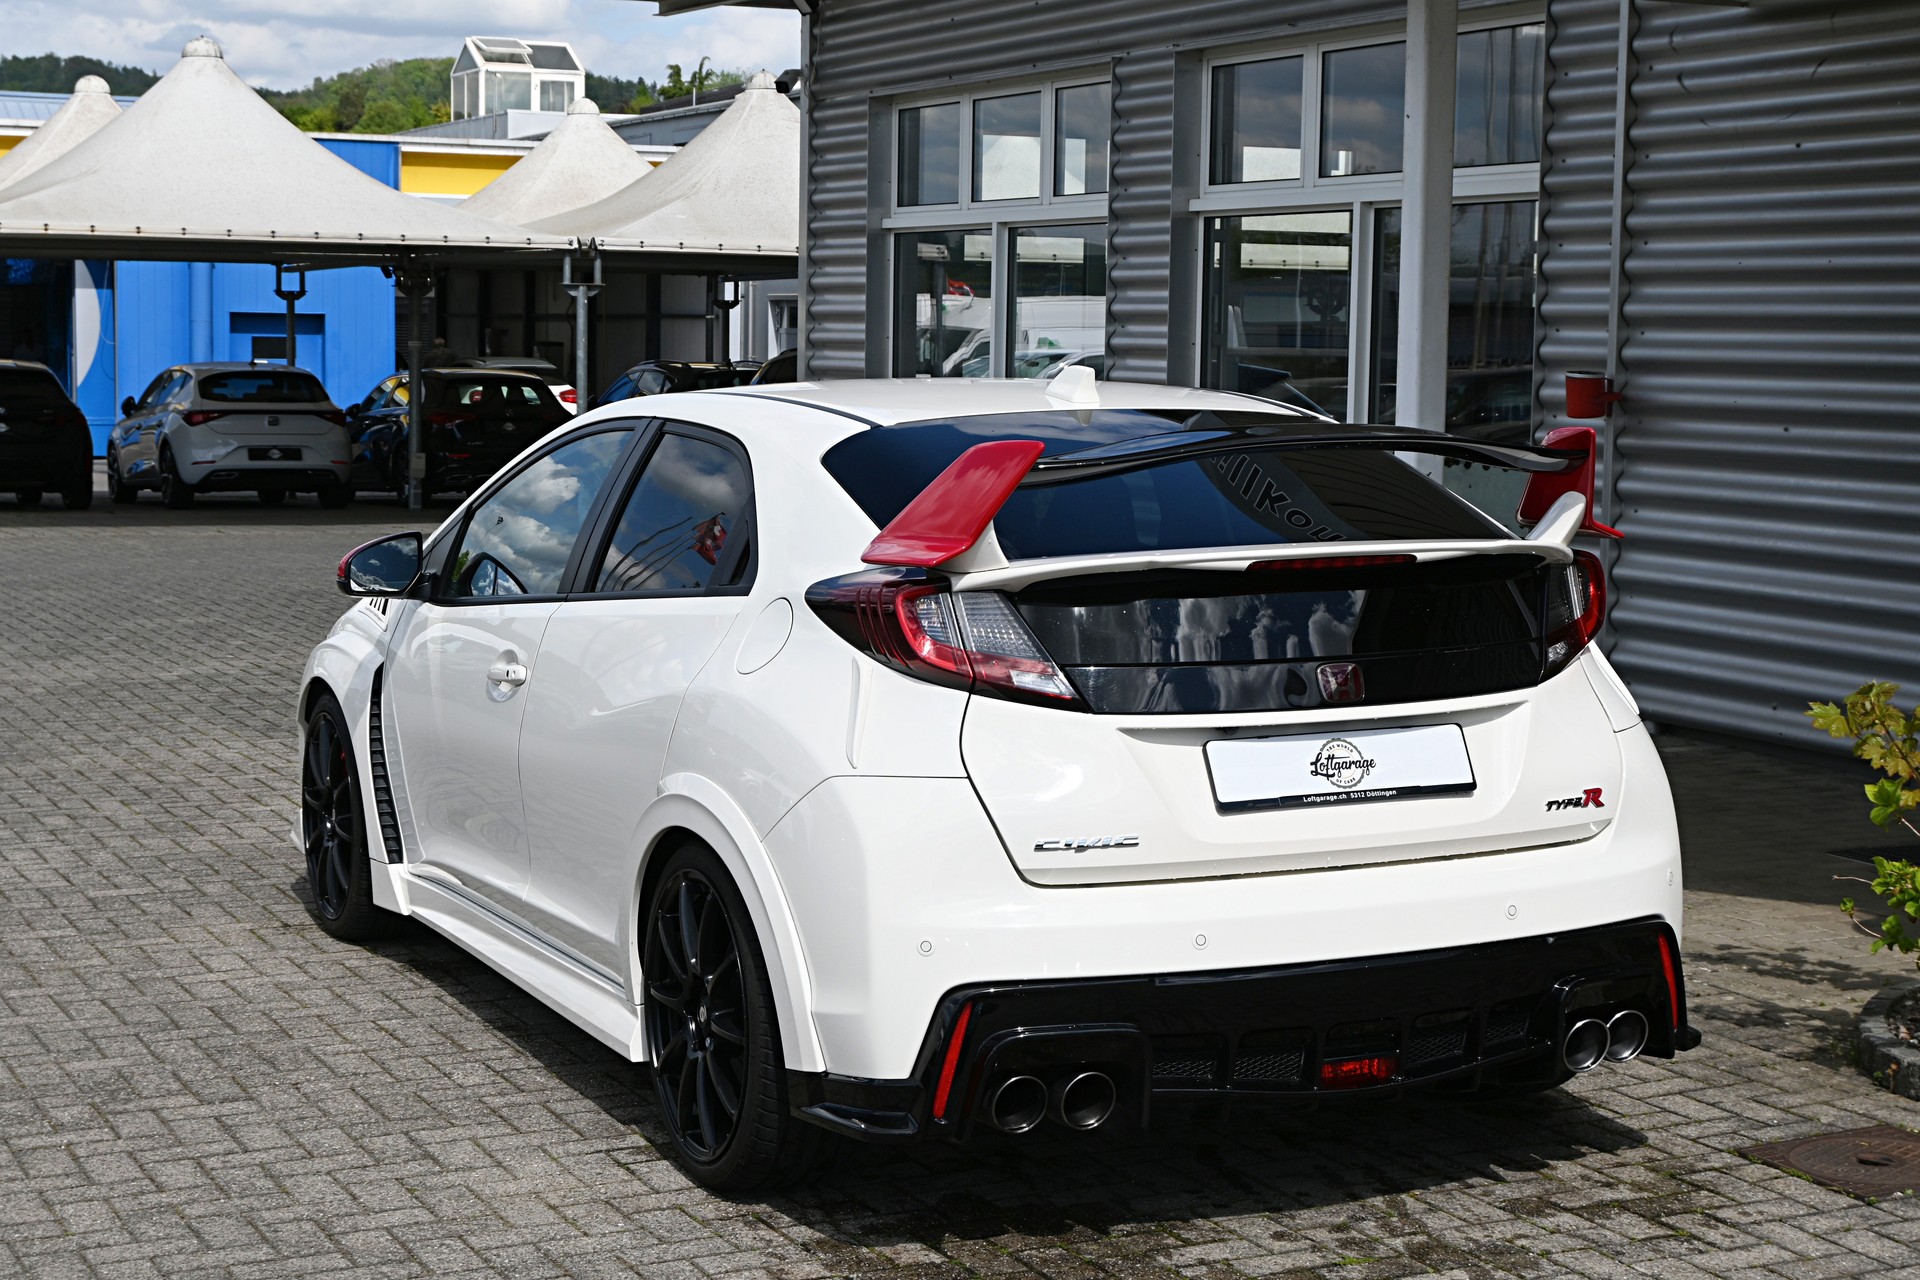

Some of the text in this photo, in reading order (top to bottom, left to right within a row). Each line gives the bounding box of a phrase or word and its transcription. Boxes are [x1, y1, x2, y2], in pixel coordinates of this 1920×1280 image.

[1310, 752, 1376, 781] Loftgarage
[1303, 790, 1397, 802] Loftgarage.ch 5312 Döttingen
[1034, 834, 1139, 853] CIVIC
